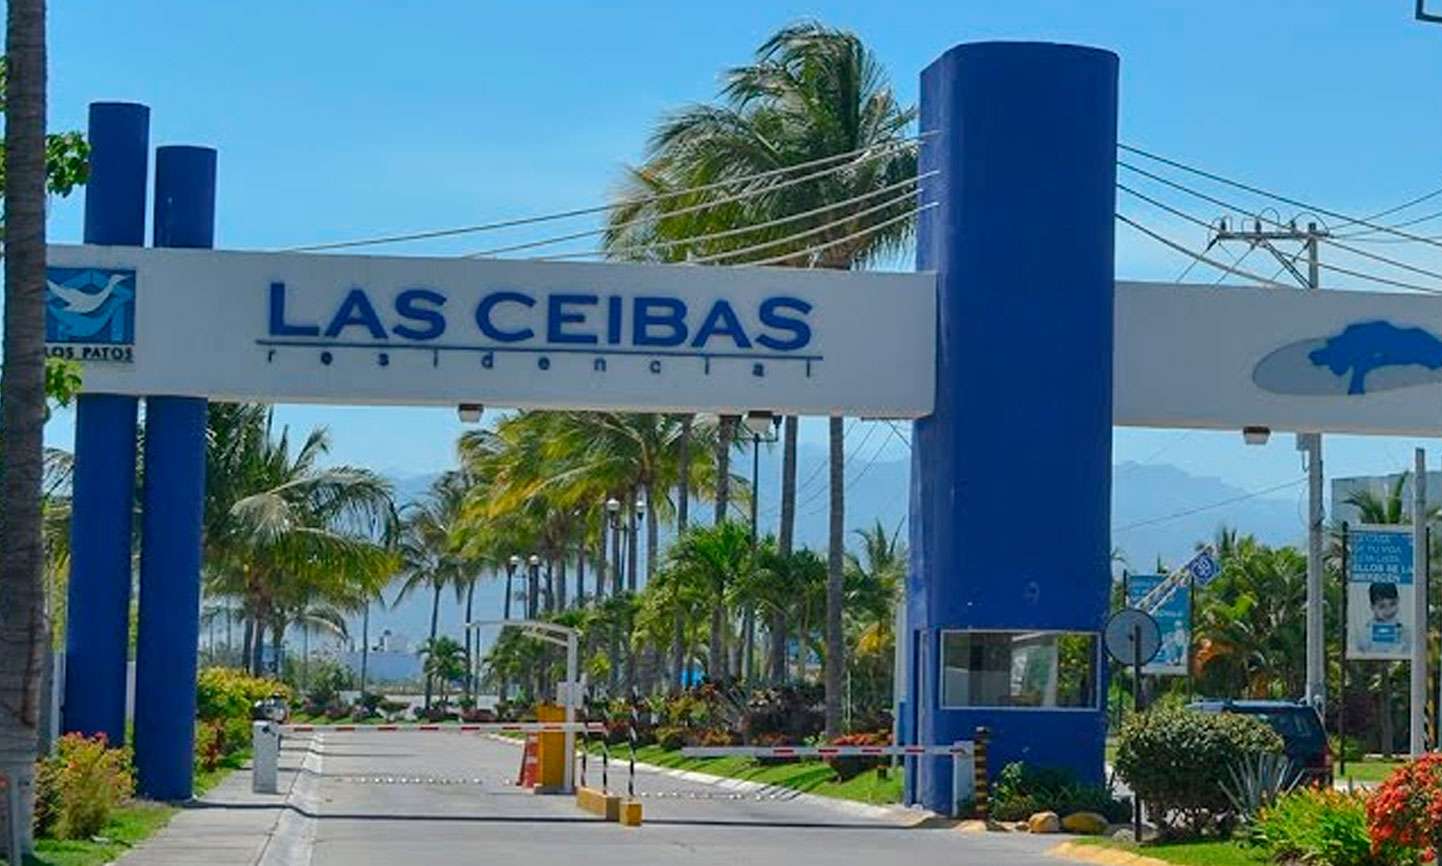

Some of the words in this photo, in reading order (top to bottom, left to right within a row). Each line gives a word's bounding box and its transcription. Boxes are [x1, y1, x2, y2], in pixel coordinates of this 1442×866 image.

[268, 281, 448, 341] LAS
[474, 290, 814, 351] CEIBAS
[44, 346, 74, 359] LOS
[82, 346, 134, 363] PATOS
[268, 349, 811, 378] residencial
